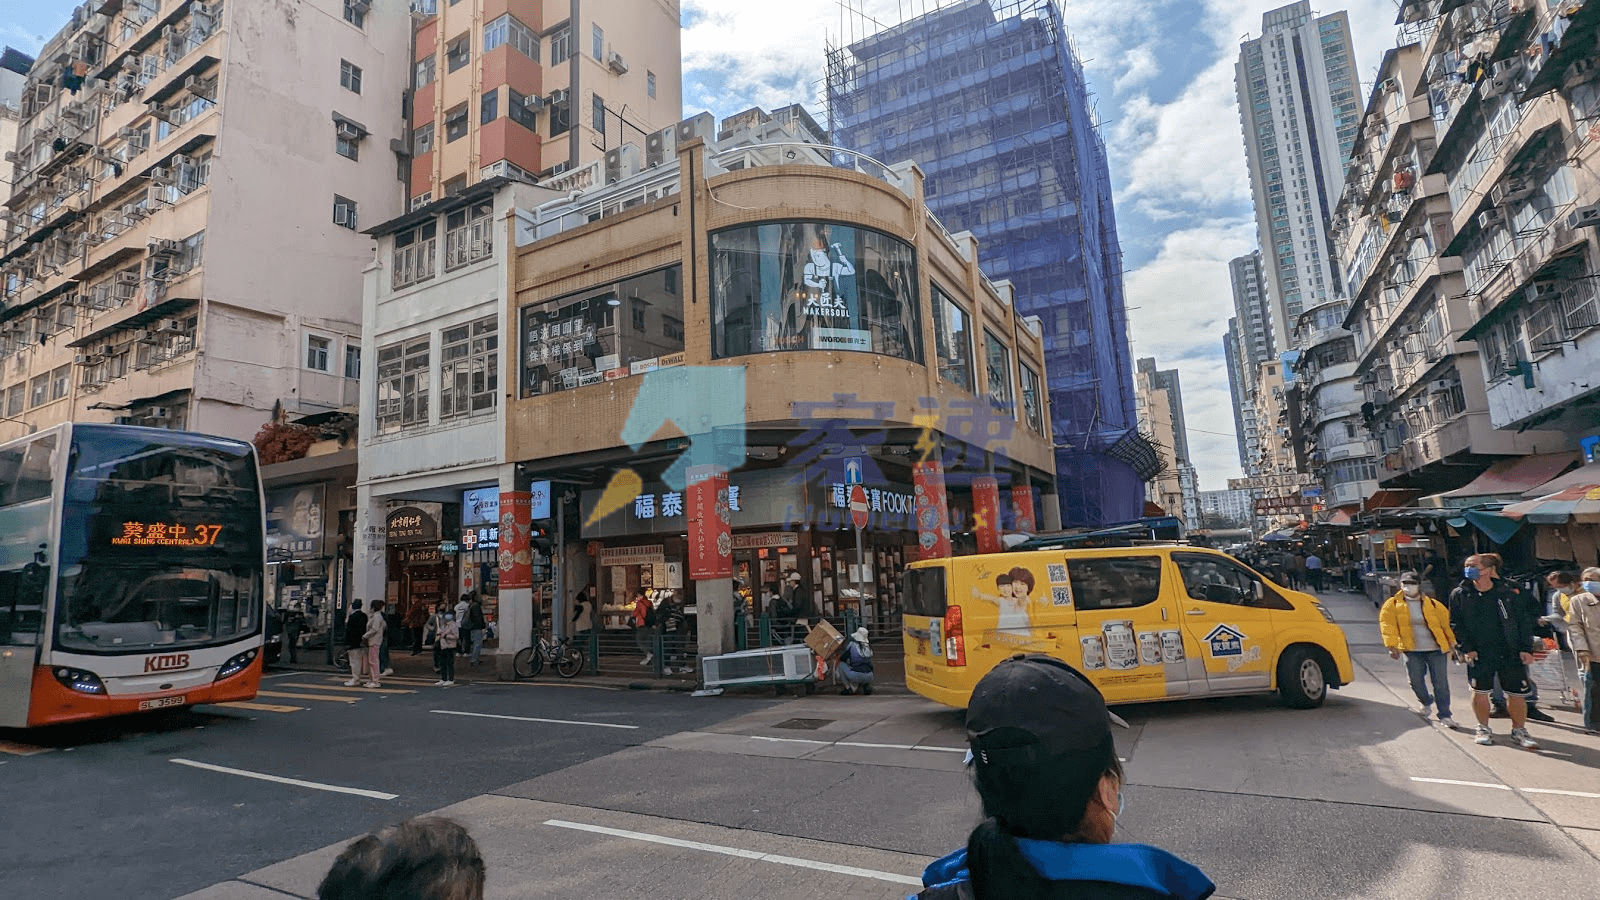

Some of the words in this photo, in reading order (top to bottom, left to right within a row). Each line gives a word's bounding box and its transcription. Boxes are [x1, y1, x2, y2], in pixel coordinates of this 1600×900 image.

[807, 292, 846, 309] 大匠夫
[803, 307, 850, 317] MAKERSOUL
[640, 361, 657, 370] BOSCH
[882, 491, 908, 514] FOOK
[122, 521, 186, 538] 葵盛中
[194, 524, 223, 545] 37
[157, 538, 195, 546] (CENTRAL)
[144, 653, 190, 673] KMB
[158, 697, 183, 707] 3599
